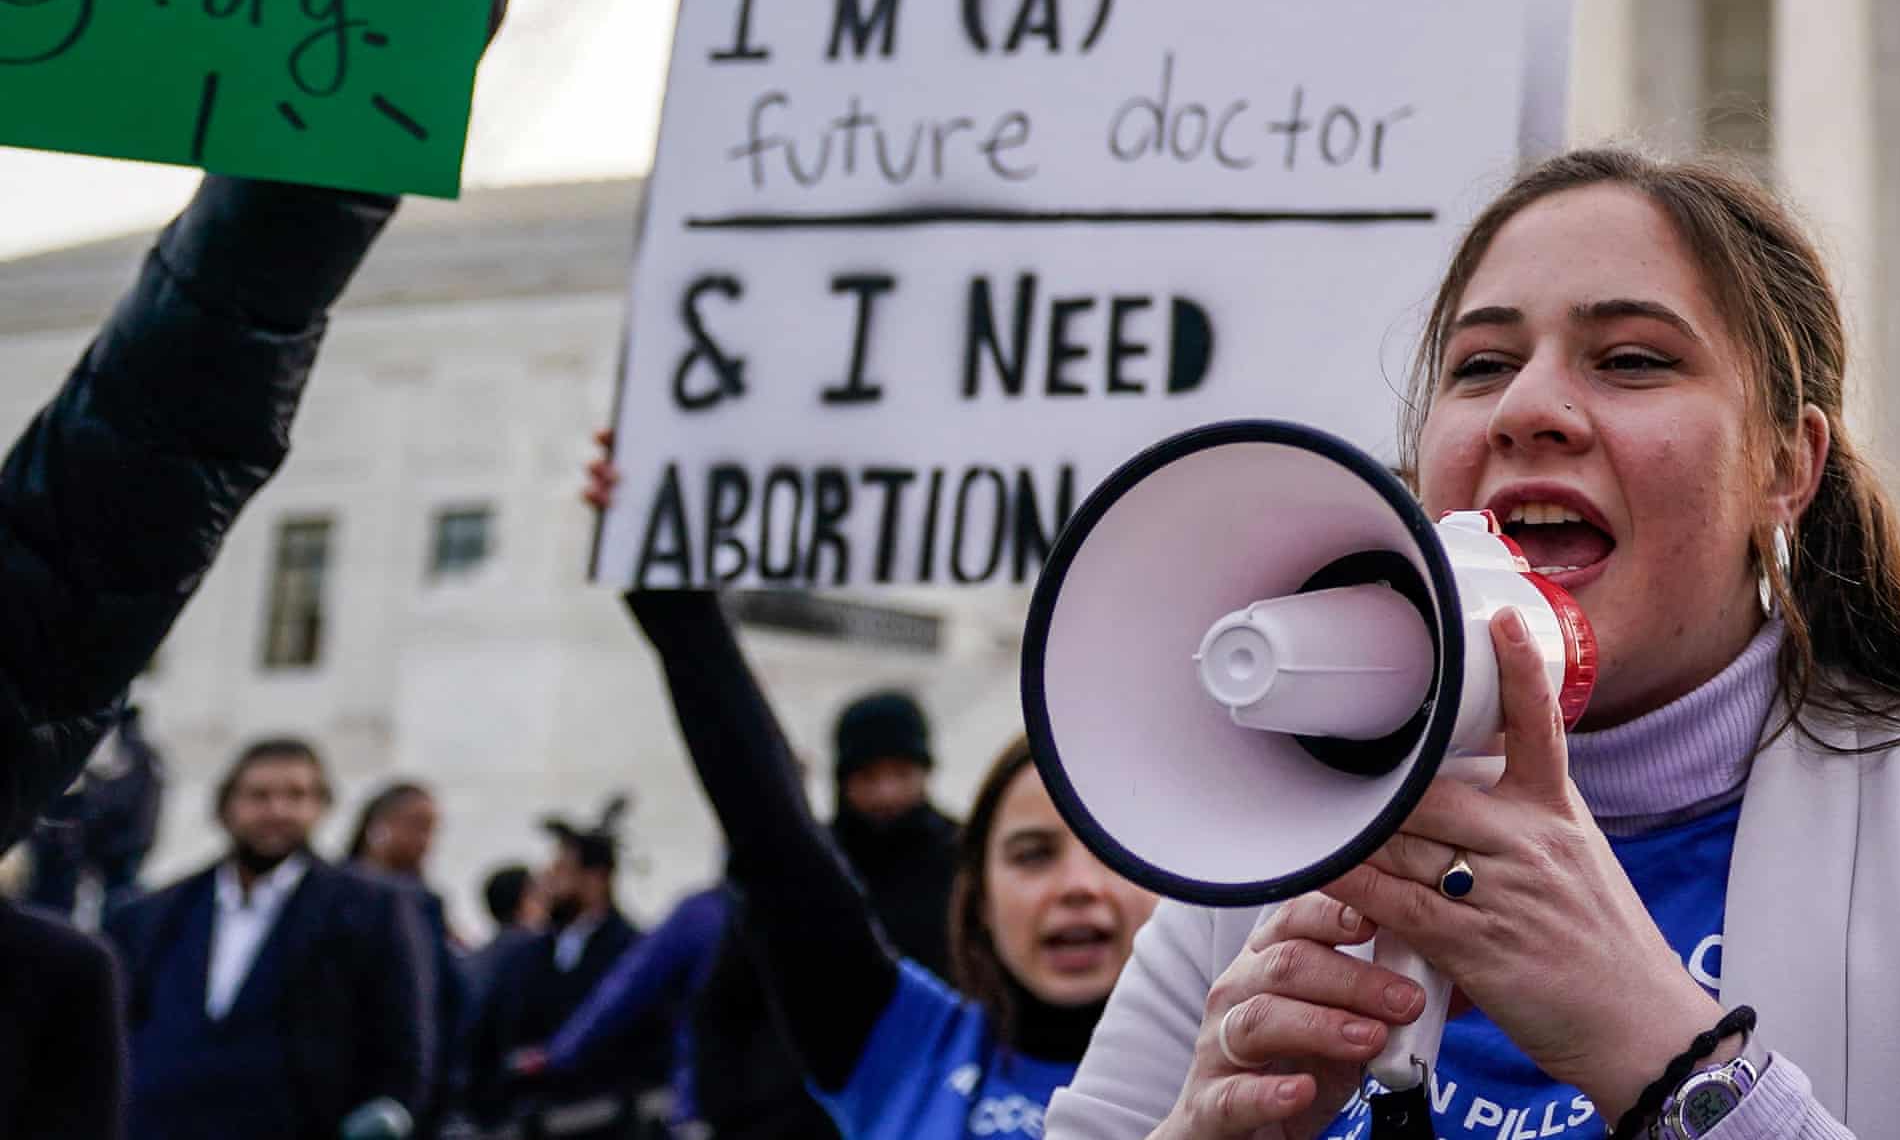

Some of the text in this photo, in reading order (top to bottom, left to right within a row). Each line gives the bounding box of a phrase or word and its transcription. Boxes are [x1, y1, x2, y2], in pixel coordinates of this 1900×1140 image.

[728, 53, 1415, 189] future doctor
[669, 270, 1217, 417] & I NEED
[632, 460, 1077, 587] ABORTION
[1463, 1094, 1596, 1140] PILLS
